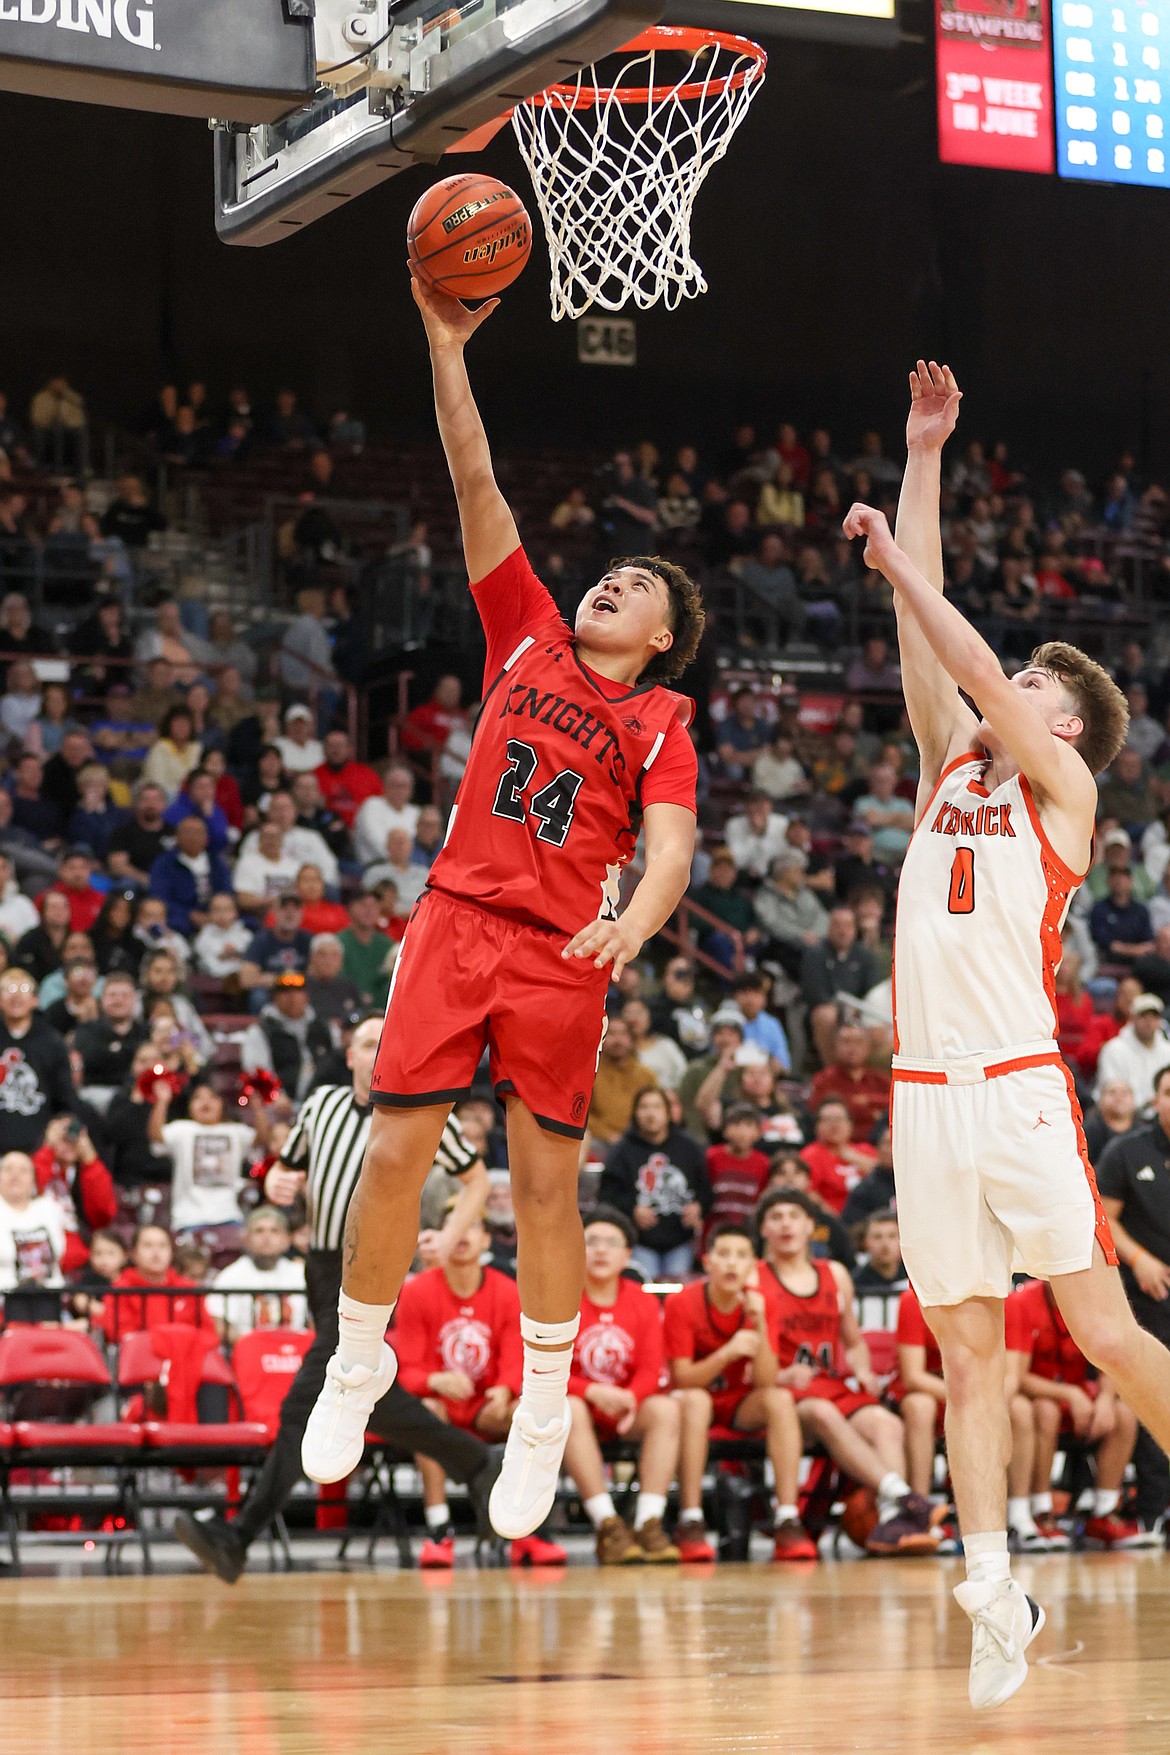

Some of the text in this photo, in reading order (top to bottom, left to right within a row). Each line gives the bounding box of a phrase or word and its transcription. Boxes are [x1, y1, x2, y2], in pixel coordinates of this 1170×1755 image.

[941, 11, 1043, 41] STAMPEDE
[982, 77, 1043, 110] WEEK
[953, 102, 1038, 138] IN JUNE
[463, 222, 527, 264] Baden
[499, 684, 626, 786] KNIGHTS
[491, 737, 585, 848] 24
[948, 847, 975, 914] 0
